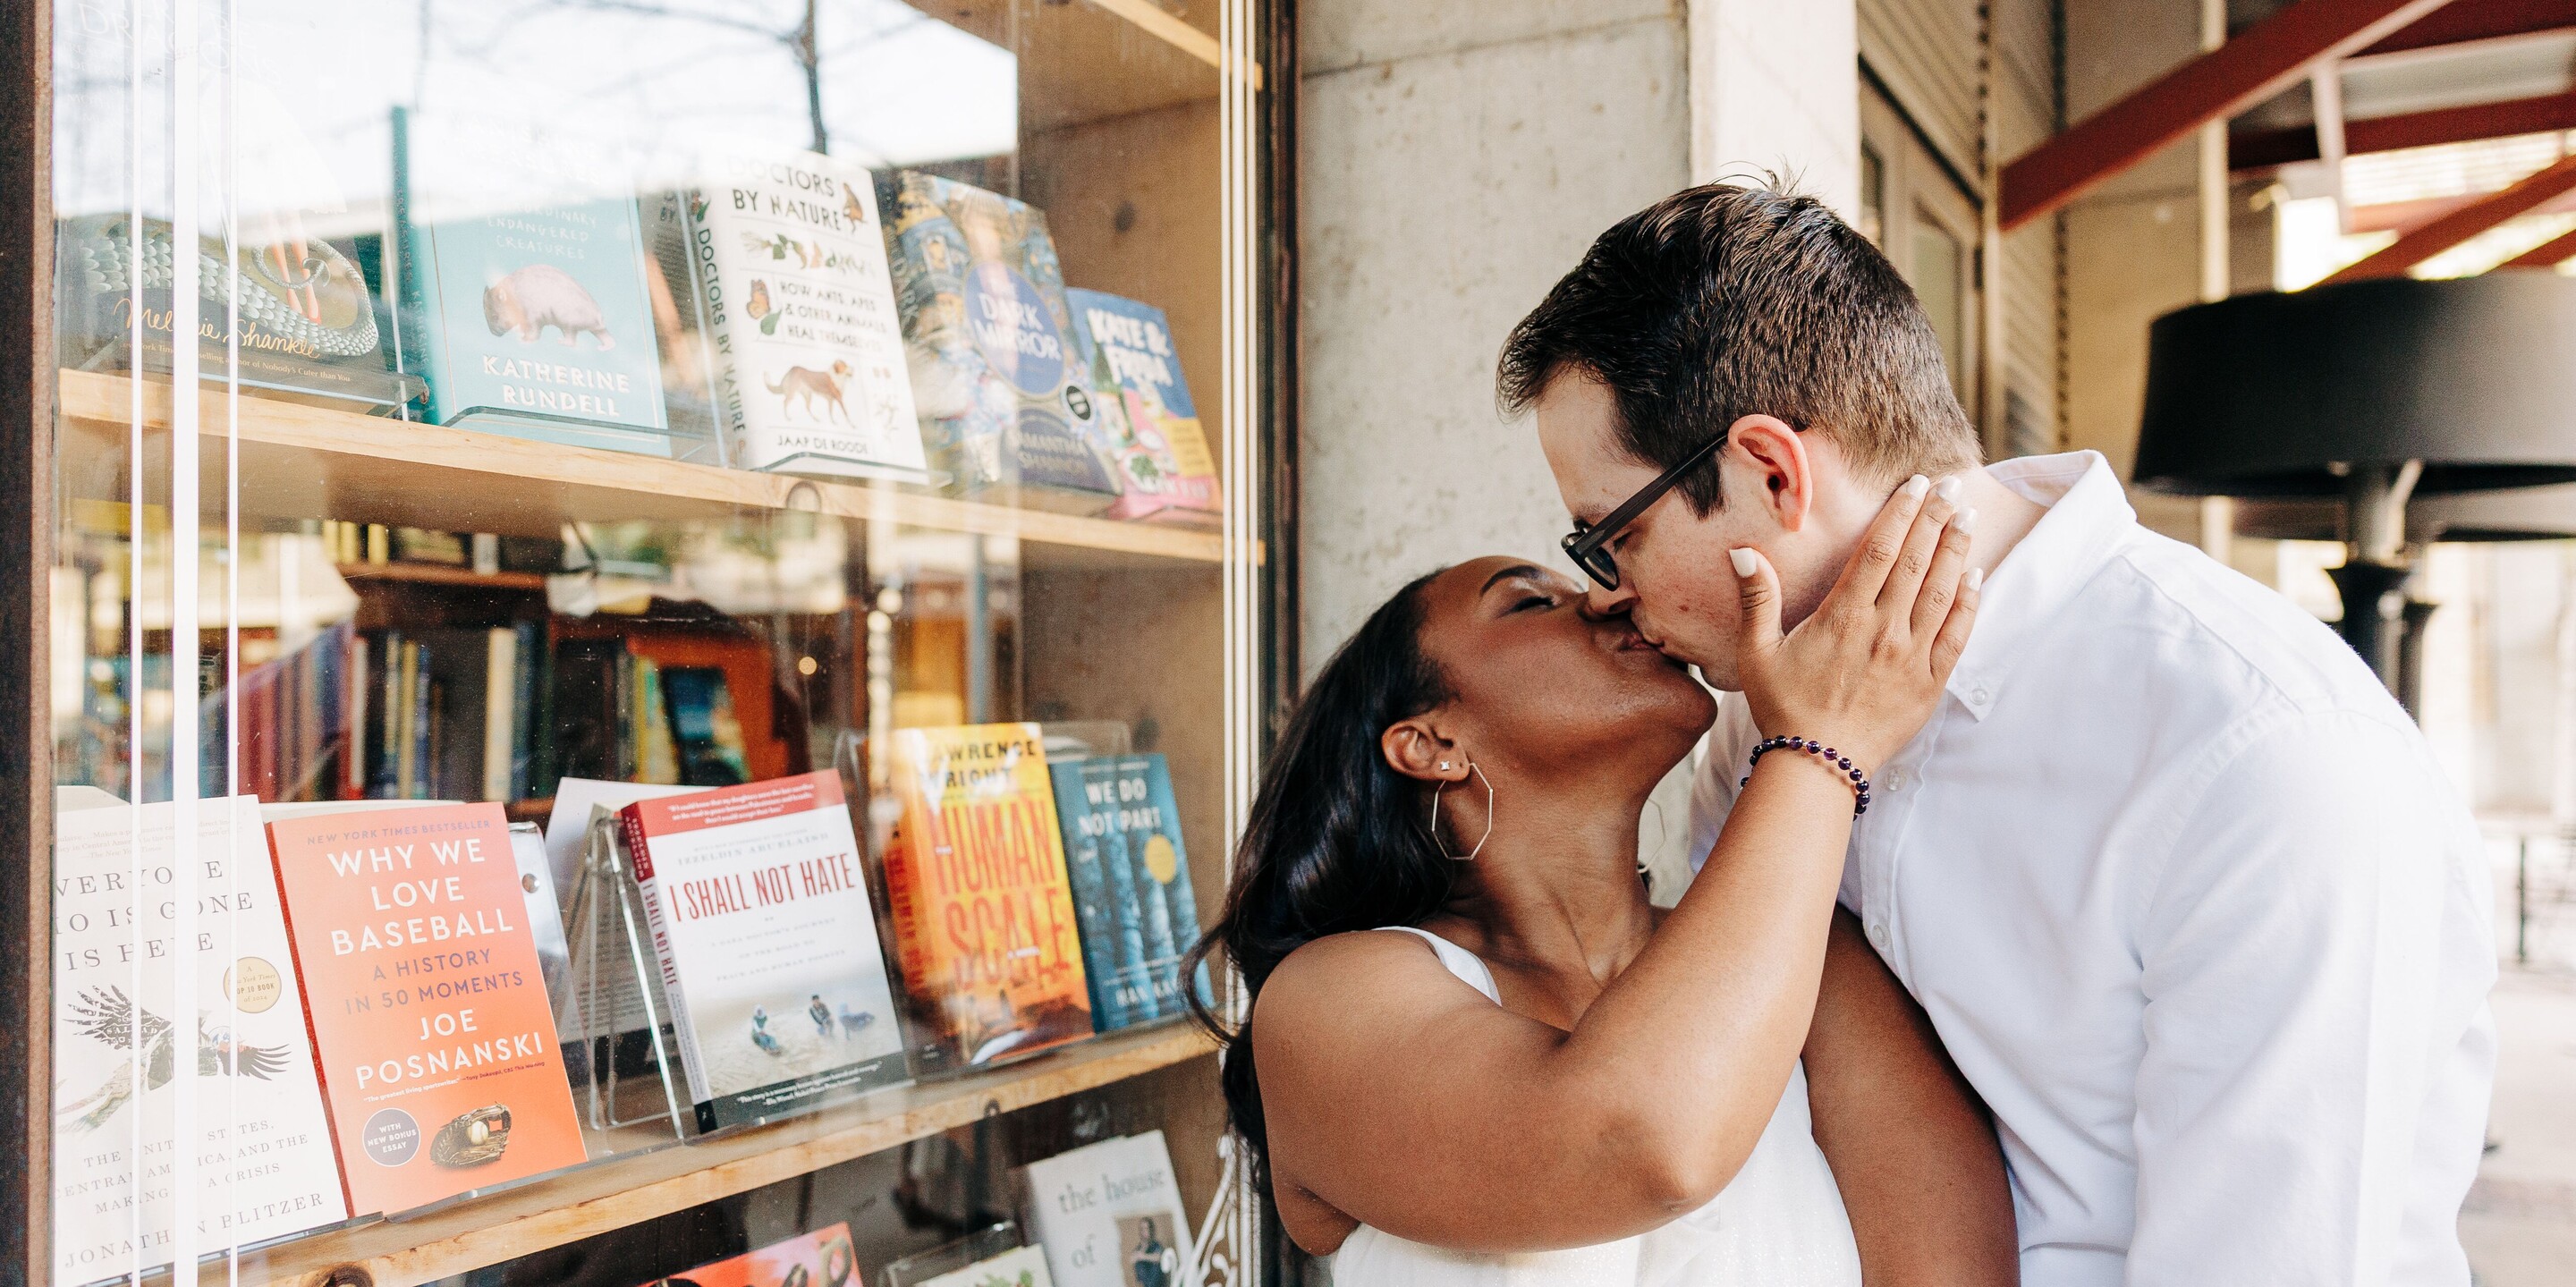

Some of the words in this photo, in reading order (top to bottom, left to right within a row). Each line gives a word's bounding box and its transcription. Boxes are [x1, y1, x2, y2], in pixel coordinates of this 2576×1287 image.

[732, 188, 758, 212] BY
[769, 193, 842, 231] NATURE
[496, 234, 586, 260] CREATURES
[699, 228, 726, 326] DOCTORS
[114, 298, 221, 339] Melie
[979, 292, 1045, 332] DARK
[716, 334, 733, 355] BY
[482, 353, 631, 394] KATHERINE
[503, 385, 621, 418] RUNDELL
[724, 363, 746, 435] NATURE
[932, 740, 1037, 763] AWRENCE
[1084, 780, 1116, 805] WE
[1118, 777, 1147, 802] DO
[307, 834, 338, 845] NEW
[343, 829, 377, 842] YORK
[382, 824, 419, 836] TIMES
[421, 819, 491, 834] BESTSELLER
[1077, 810, 1114, 836] NOT
[326, 843, 414, 878] WHY
[429, 838, 486, 867] WE
[927, 794, 1057, 895] HUMAN
[370, 876, 465, 911] LOVE
[669, 885, 682, 923] I
[683, 873, 752, 920] SHALL
[752, 863, 796, 908] NOT
[799, 851, 858, 899] HATE
[330, 908, 513, 956] BASEBALL
[64, 948, 101, 971] IS
[117, 932, 214, 963] HEE
[372, 965, 386, 982] A
[396, 948, 491, 978] HISTORY
[345, 995, 371, 1016] IN
[382, 988, 410, 1009] 50
[418, 970, 524, 1003] MOMENTS
[419, 1008, 479, 1041] JOE
[355, 1031, 544, 1090] POSNANSKI
[83, 1151, 122, 1168] THE
[207, 1120, 275, 1141] STTES,
[238, 1142, 270, 1158] AND
[275, 1134, 309, 1150] THE
[367, 1136, 386, 1147] NEW
[388, 1129, 417, 1141] BONUS
[378, 1122, 402, 1133] WITH
[382, 1141, 407, 1153] ESSAY
[94, 1188, 170, 1215] MAKNG
[207, 1178, 217, 1188] A
[1058, 1181, 1097, 1215] the
[64, 1220, 208, 1268] JONATHN
[220, 1192, 324, 1230] BLITZER
[1072, 1232, 1097, 1269] of
